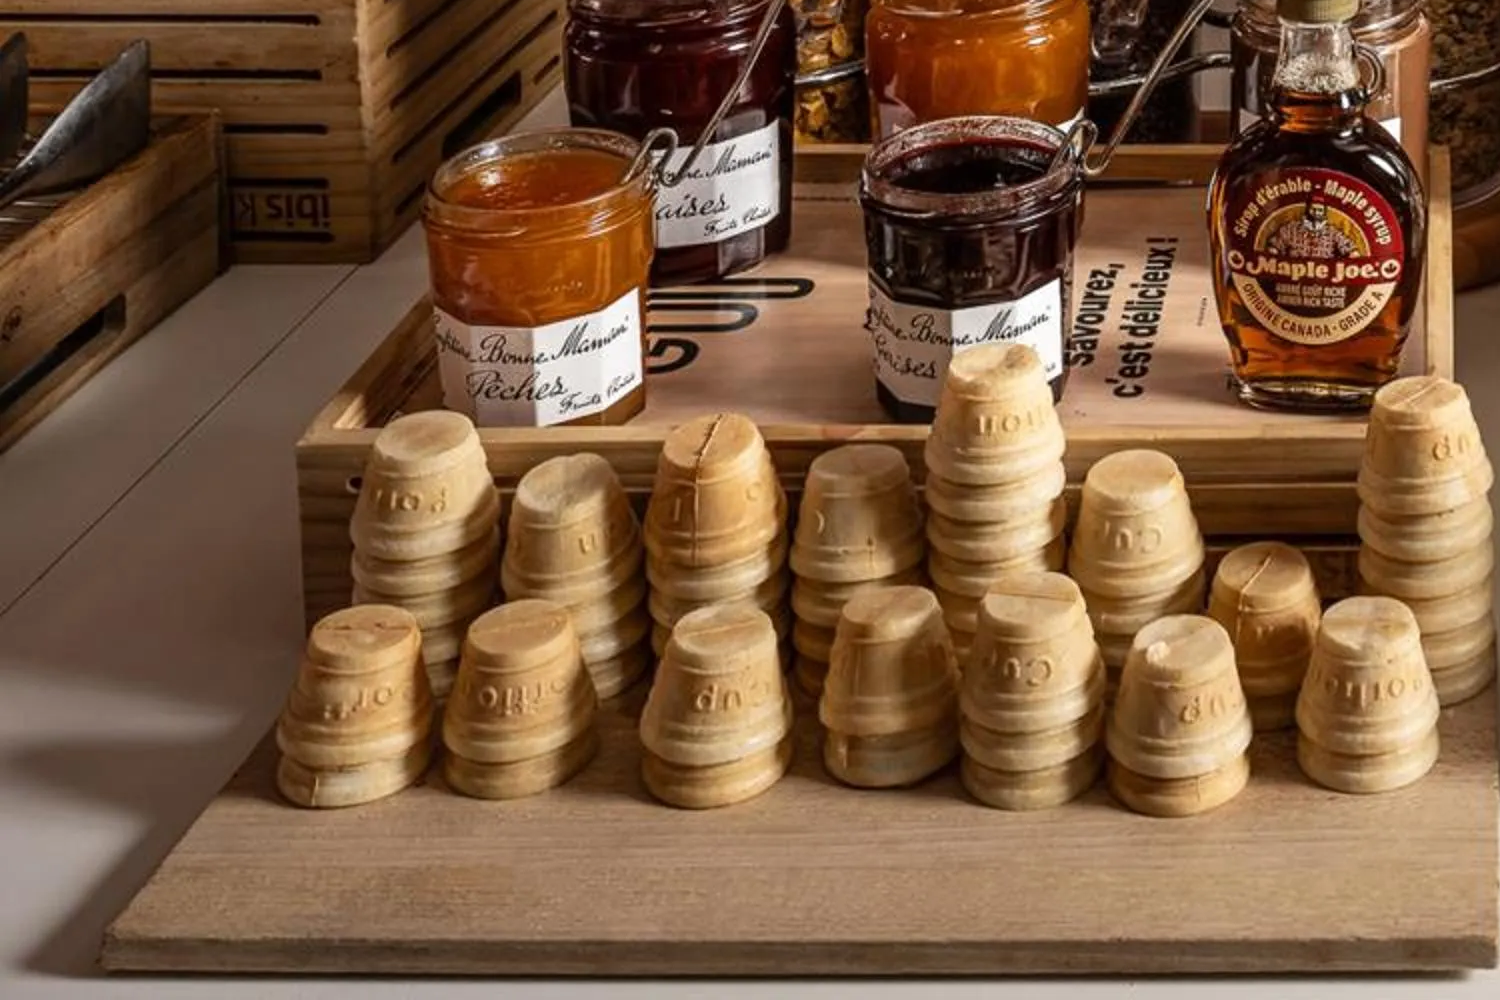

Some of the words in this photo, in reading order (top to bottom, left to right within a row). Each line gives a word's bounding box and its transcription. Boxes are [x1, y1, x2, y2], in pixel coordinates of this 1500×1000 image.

[265, 193, 331, 228] ibis
[655, 192, 731, 222] aises
[1234, 203, 1260, 238] Sirop
[1324, 179, 1369, 211] Maple
[1364, 204, 1393, 246] syrup
[1246, 256, 1329, 281] Maple
[1331, 261, 1379, 283] Joe
[907, 313, 974, 347] Bonne
[975, 308, 1050, 344] Maman
[1241, 281, 1281, 328] ORIGINE
[1280, 317, 1332, 339] CANADA
[1338, 300, 1378, 332] GRADE
[479, 333, 549, 365] Bonne
[551, 321, 629, 361] Maman
[465, 370, 568, 402] Pêches
[1104, 340, 1155, 398] c'est
